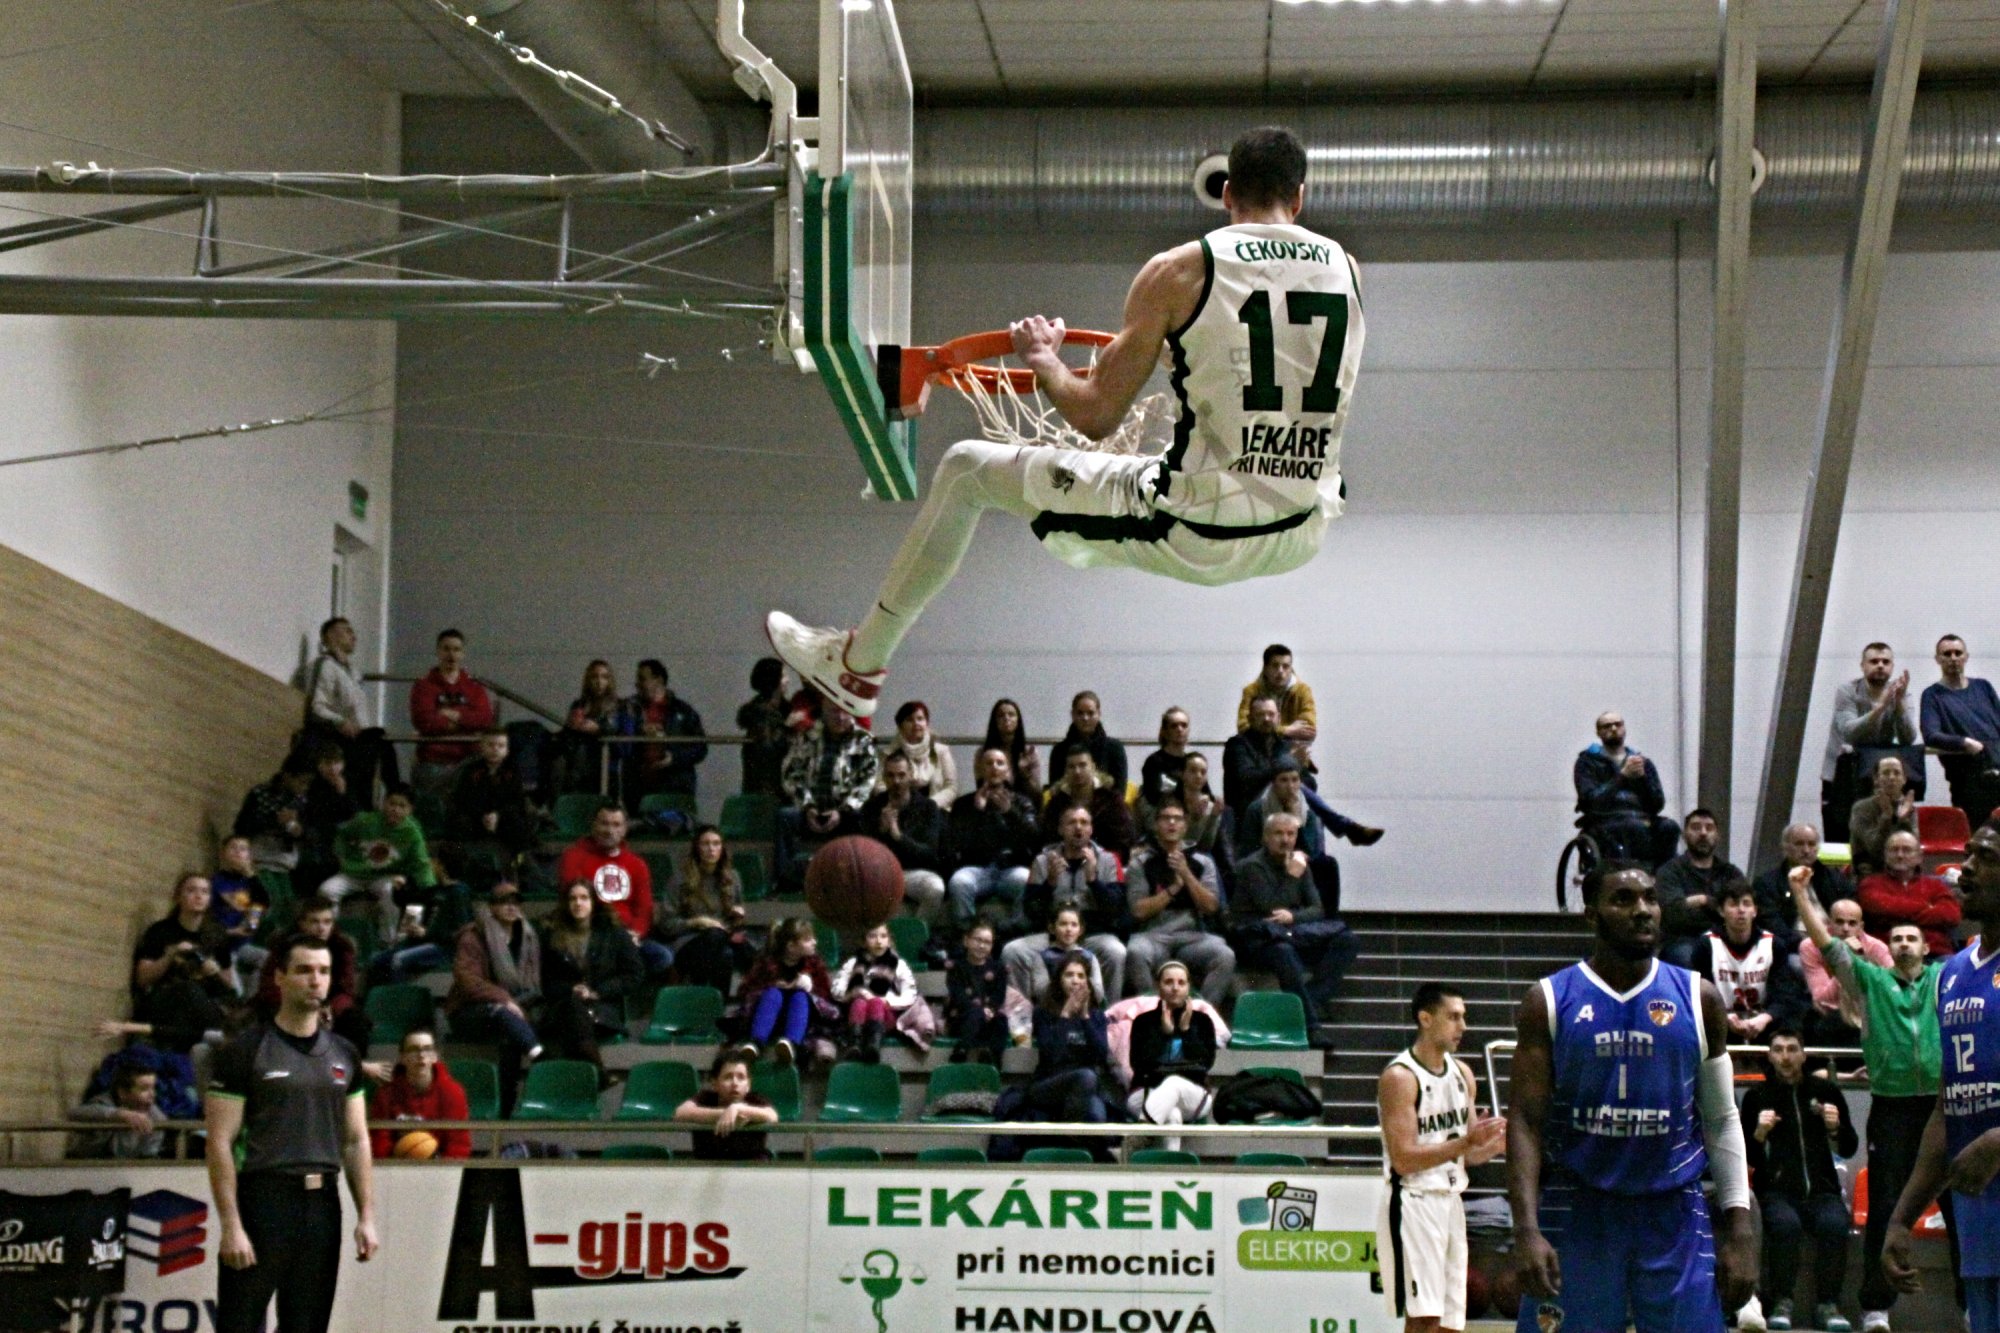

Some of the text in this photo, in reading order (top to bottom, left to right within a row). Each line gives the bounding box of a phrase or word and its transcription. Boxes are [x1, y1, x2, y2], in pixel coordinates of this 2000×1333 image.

[1234, 239, 1330, 266] ČEKOVSKÝ
[1238, 290, 1349, 413] 17
[1951, 1033, 1975, 1074] 12
[827, 1178, 1213, 1230] LEKÁREŇ
[957, 1247, 1215, 1279] pri nemocnici
[1249, 1240, 1351, 1262] ELEKTRO
[955, 1304, 1215, 1333] HANDLOVÁ
